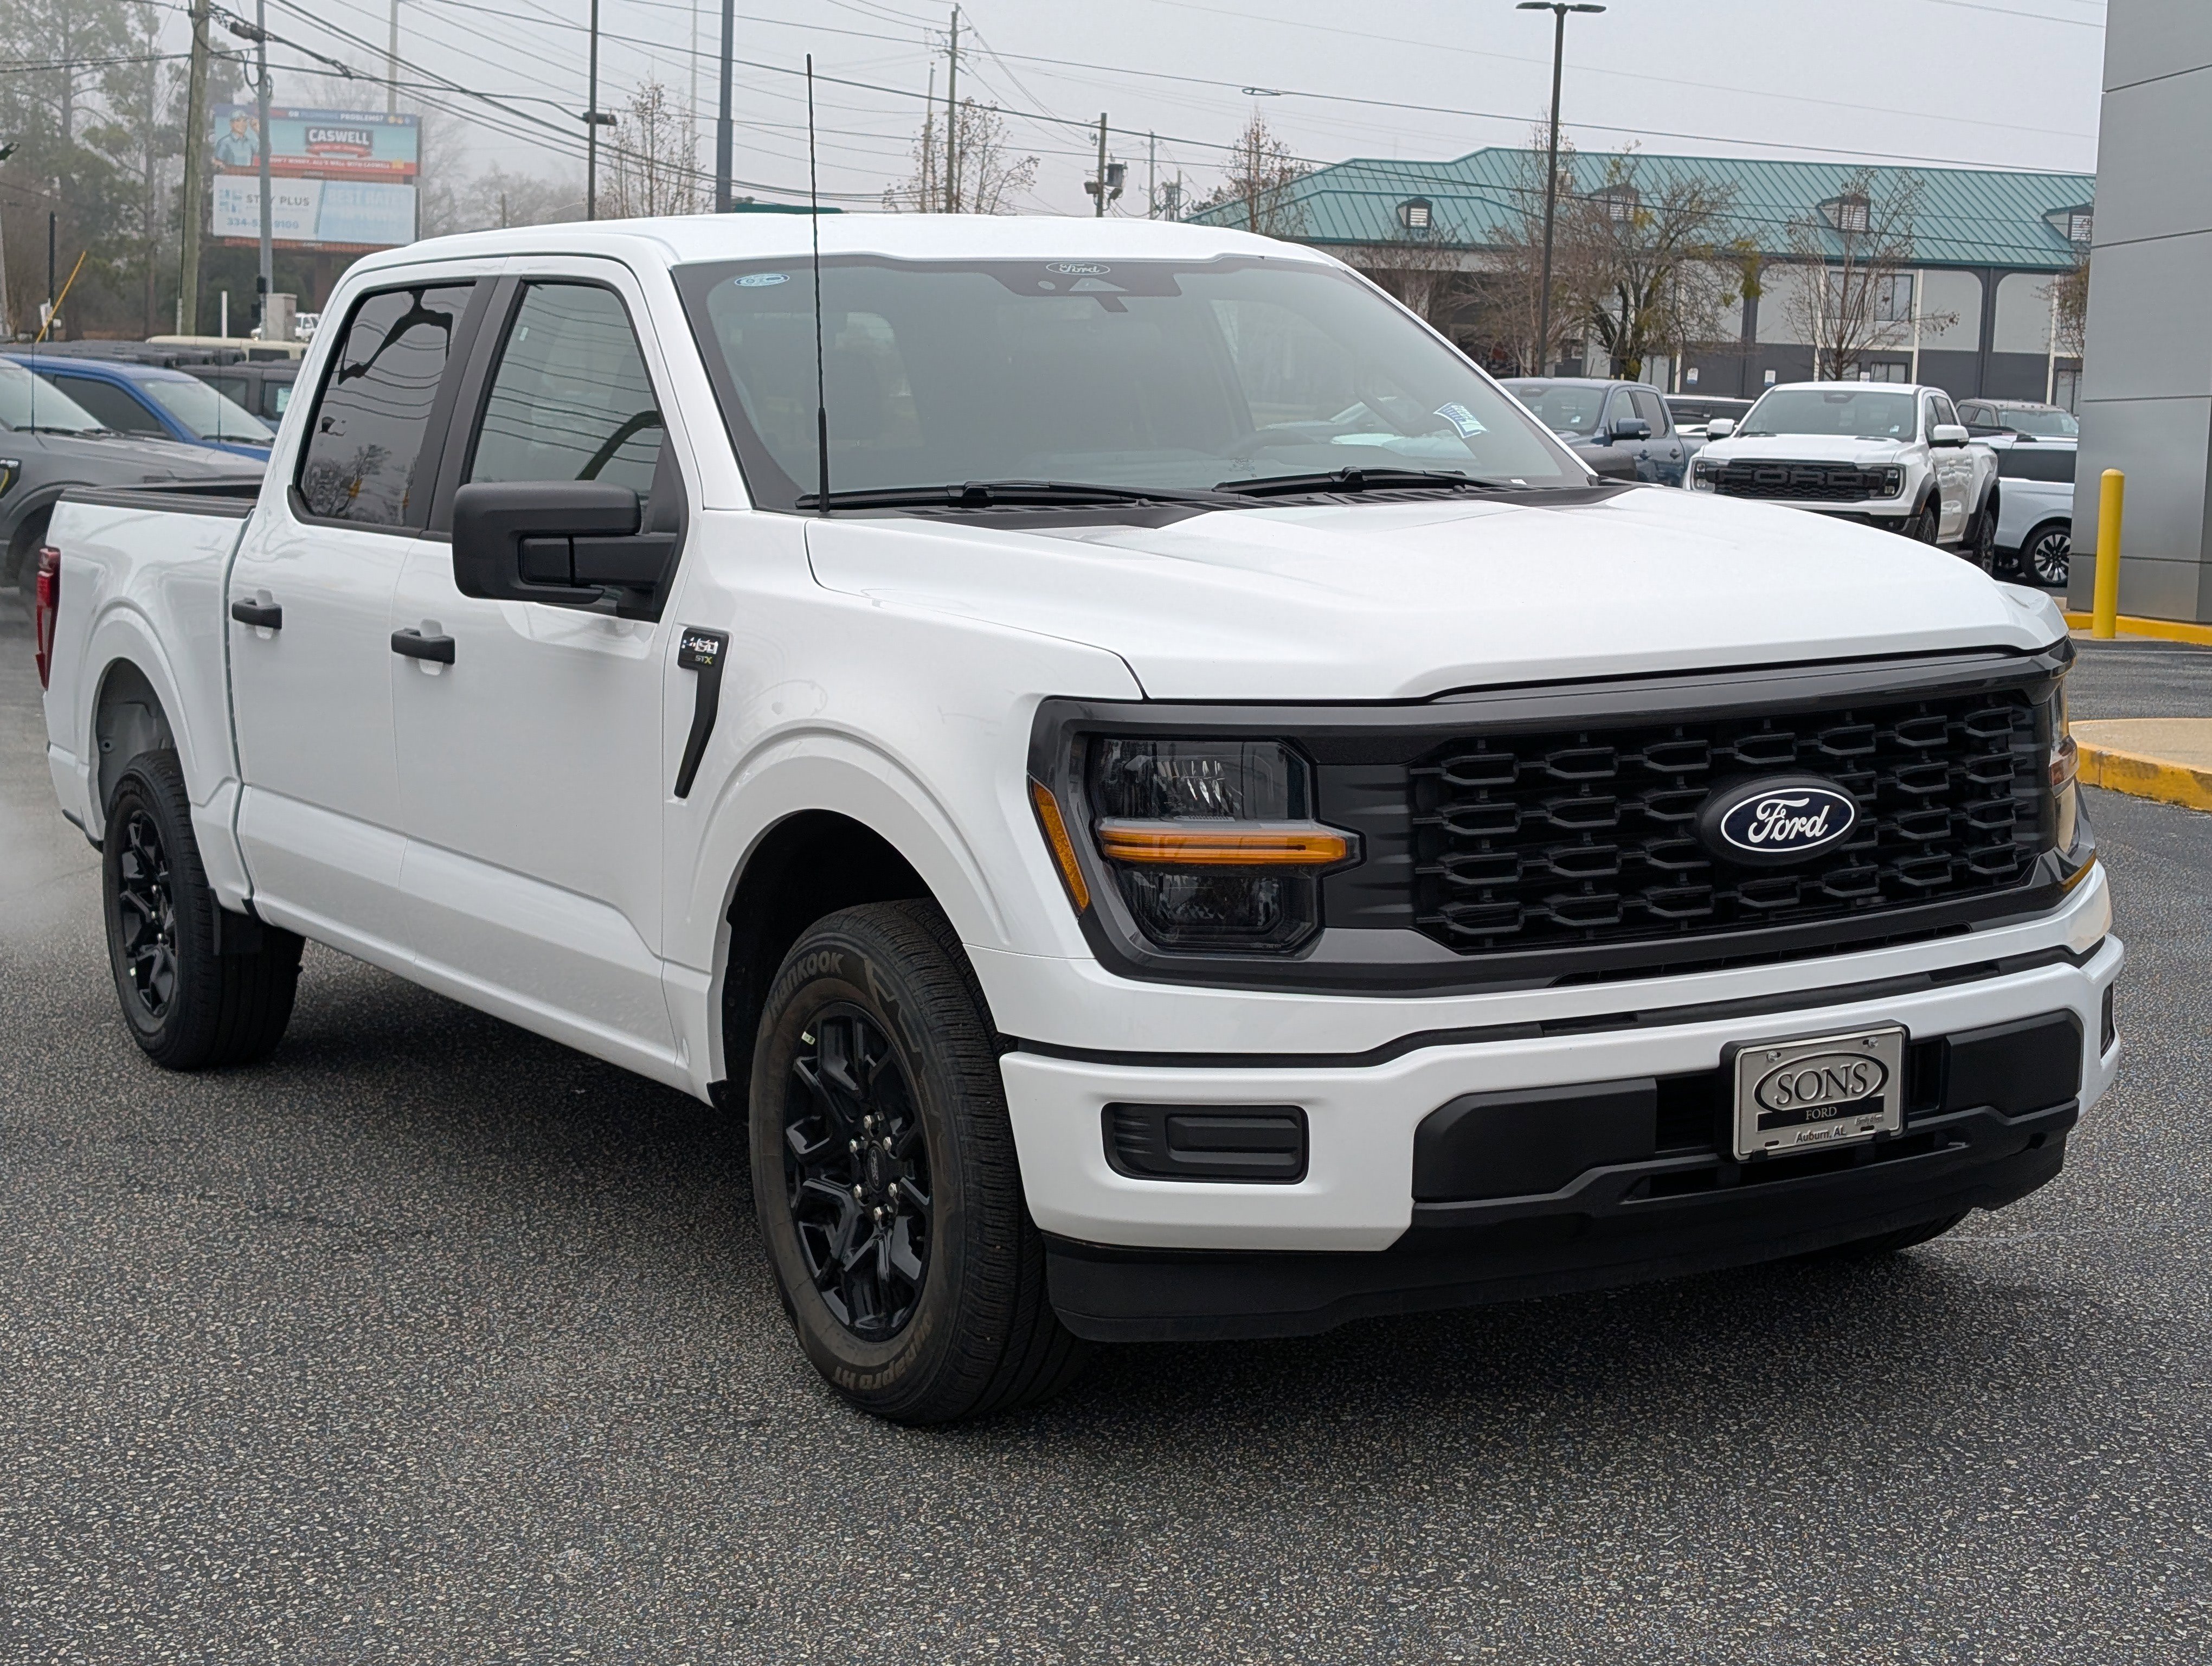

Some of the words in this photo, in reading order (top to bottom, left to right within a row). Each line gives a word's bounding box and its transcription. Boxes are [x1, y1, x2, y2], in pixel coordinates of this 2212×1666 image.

[309, 129, 369, 145] CASWELL
[280, 196, 310, 207] PLUS
[1059, 264, 1099, 273] Ford
[1718, 468, 1863, 486] FORD
[695, 655, 712, 665] STX
[1748, 798, 1830, 843] Ford
[1774, 1060, 1868, 1105] SONS
[1805, 1106, 1837, 1120] FORD
[1795, 1129, 1831, 1143] Auburn,
[1833, 1125, 1847, 1137] AL
